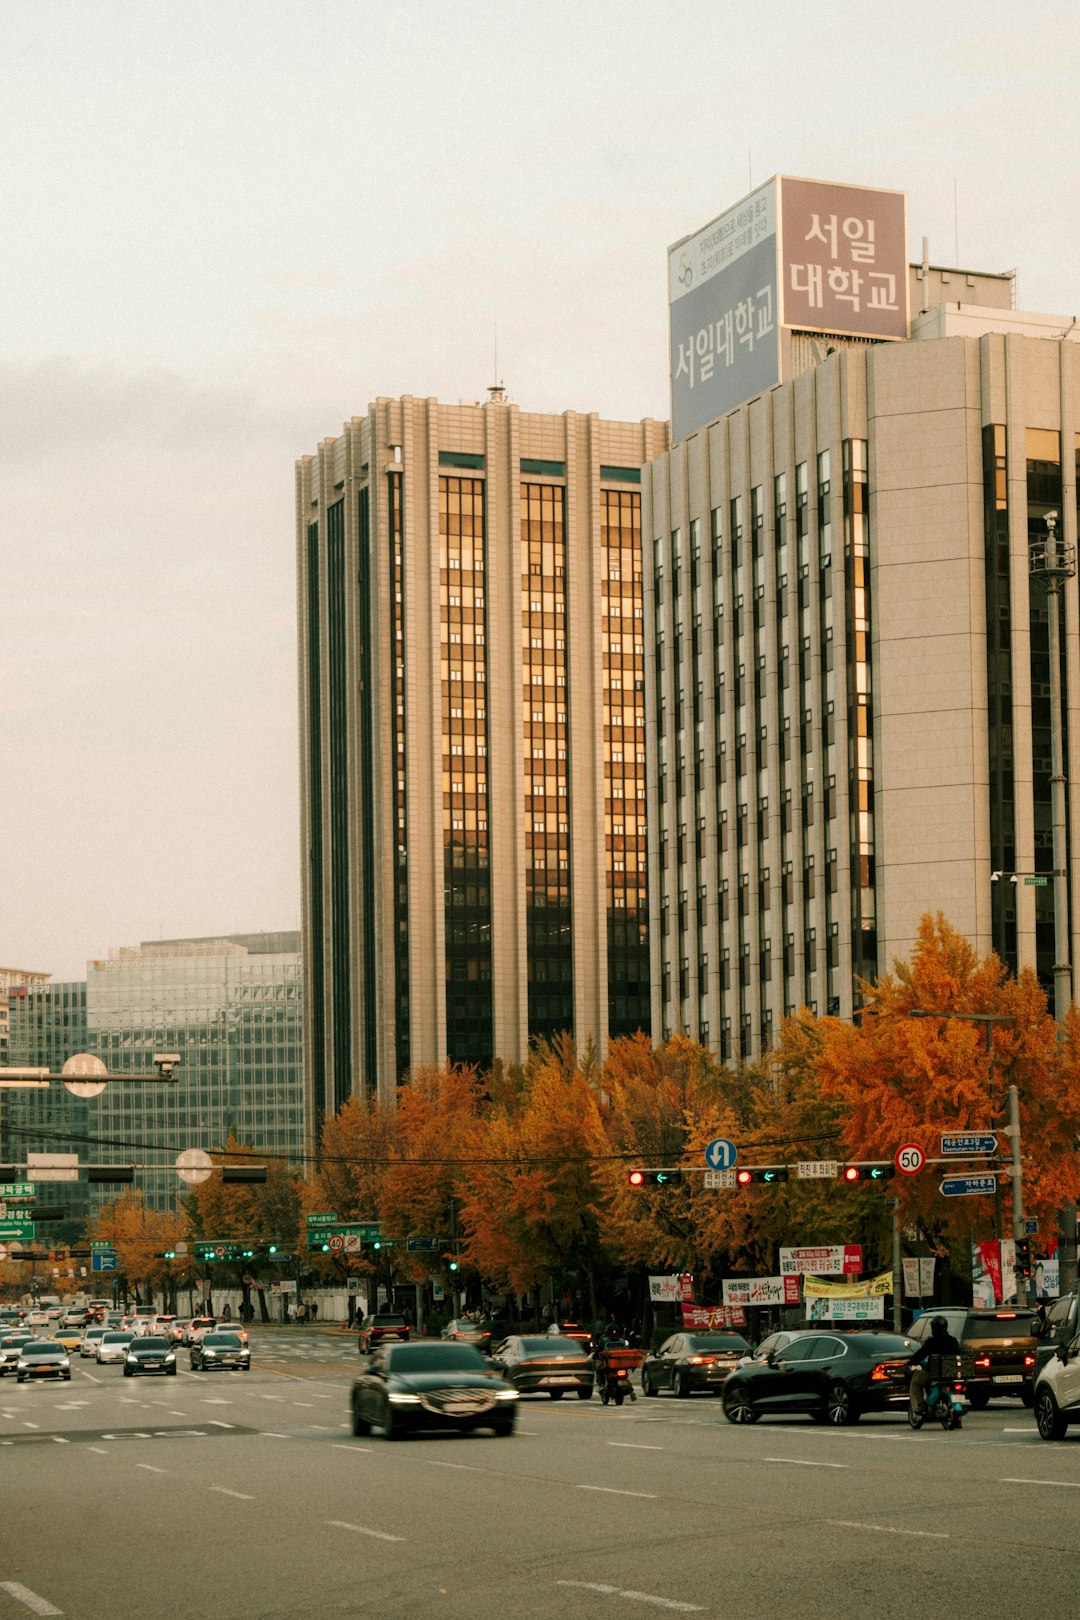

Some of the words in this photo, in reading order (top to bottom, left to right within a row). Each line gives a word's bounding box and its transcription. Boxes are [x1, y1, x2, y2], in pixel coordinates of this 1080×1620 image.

[805, 214, 875, 264] 서일
[789, 263, 900, 313] 대학교
[675, 283, 774, 390] 서일대학교
[105, 960, 138, 969] Microsoft
[901, 1152, 920, 1168] 50
[965, 1180, 993, 1188] 자하문로
[331, 1240, 341, 1248] 40
[832, 1302, 846, 1311] 2025
